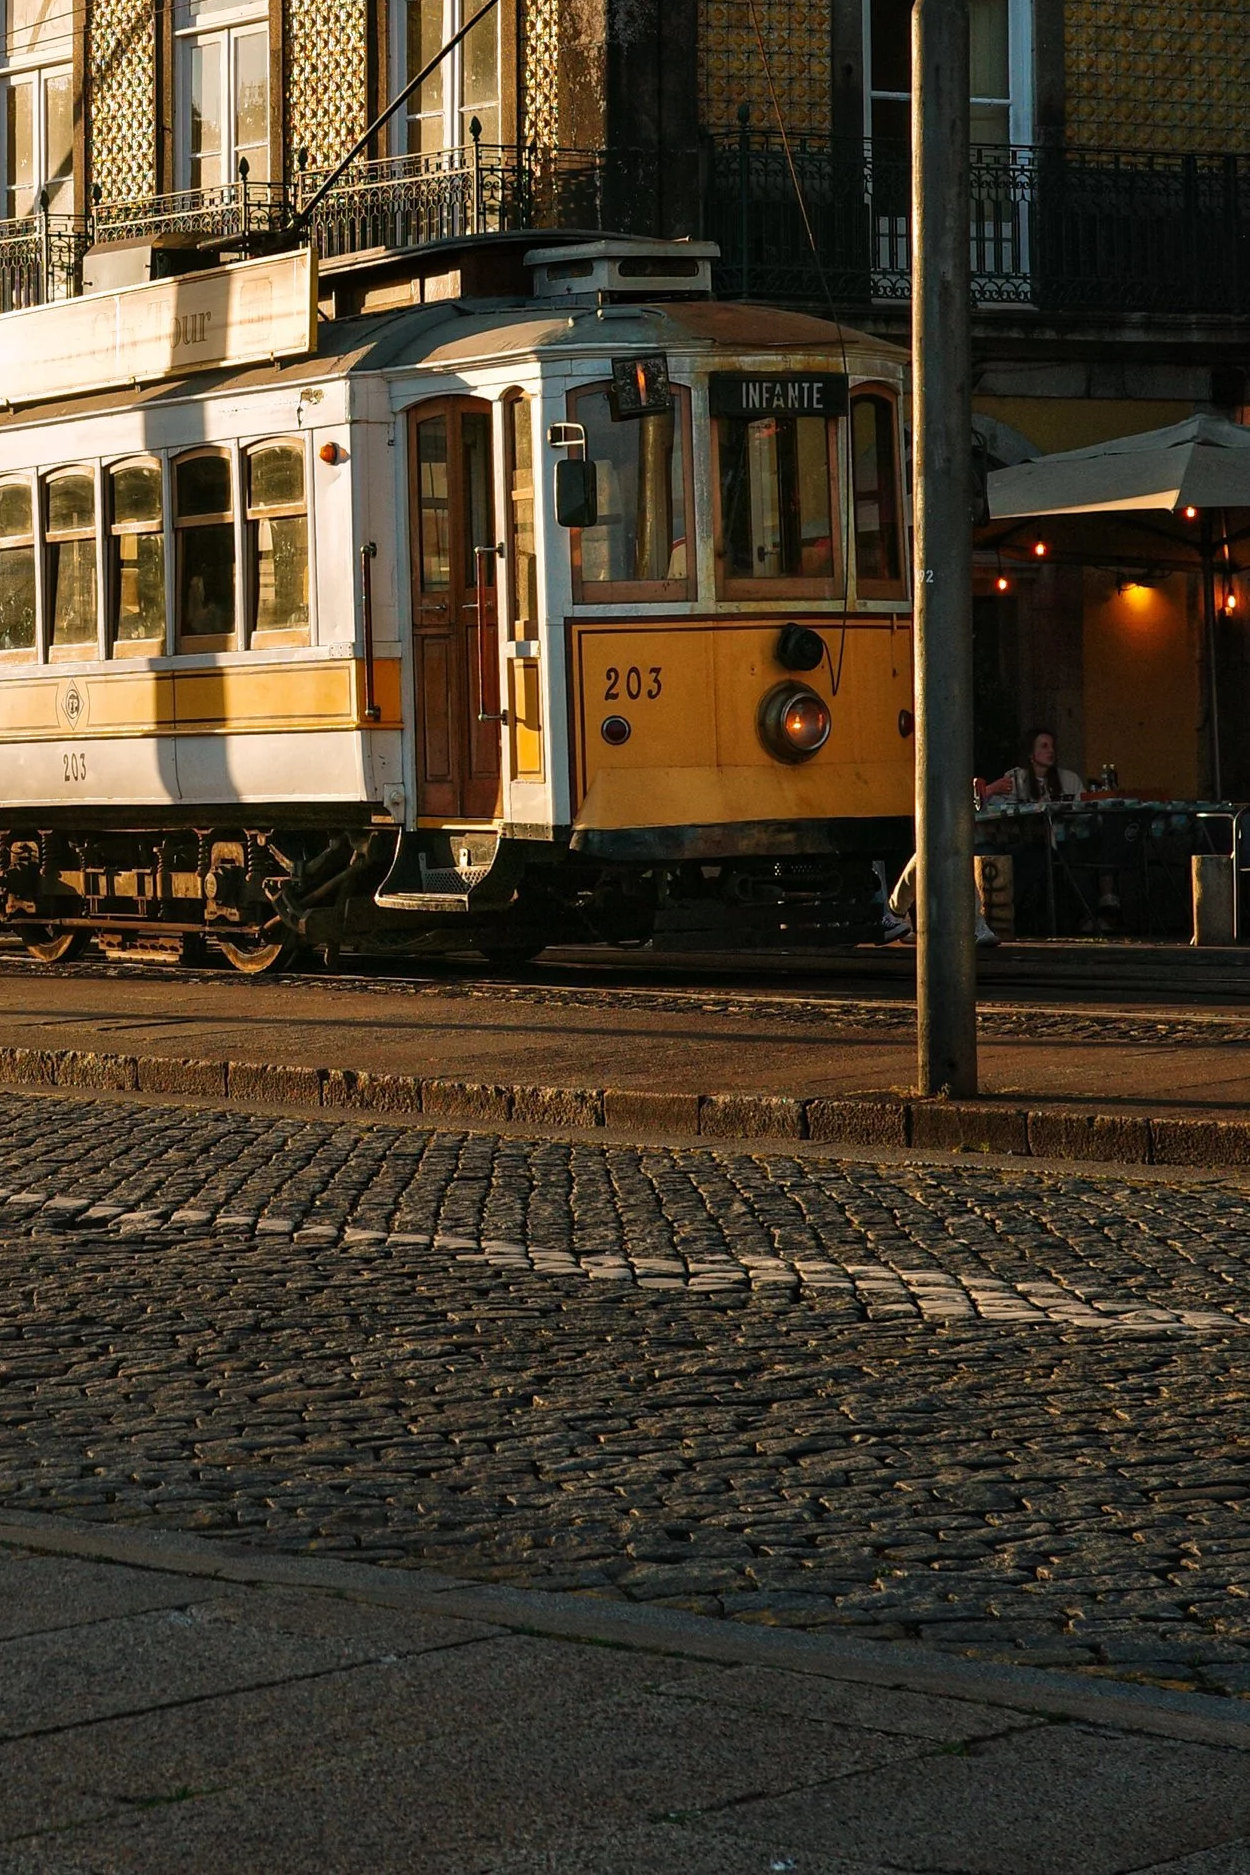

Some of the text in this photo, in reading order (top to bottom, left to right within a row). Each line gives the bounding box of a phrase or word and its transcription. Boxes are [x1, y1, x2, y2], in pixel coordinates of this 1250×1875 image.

[147, 298, 212, 350] Tour
[742, 382, 823, 408] INFANTE
[604, 666, 662, 701] 203
[63, 753, 87, 782] 203
